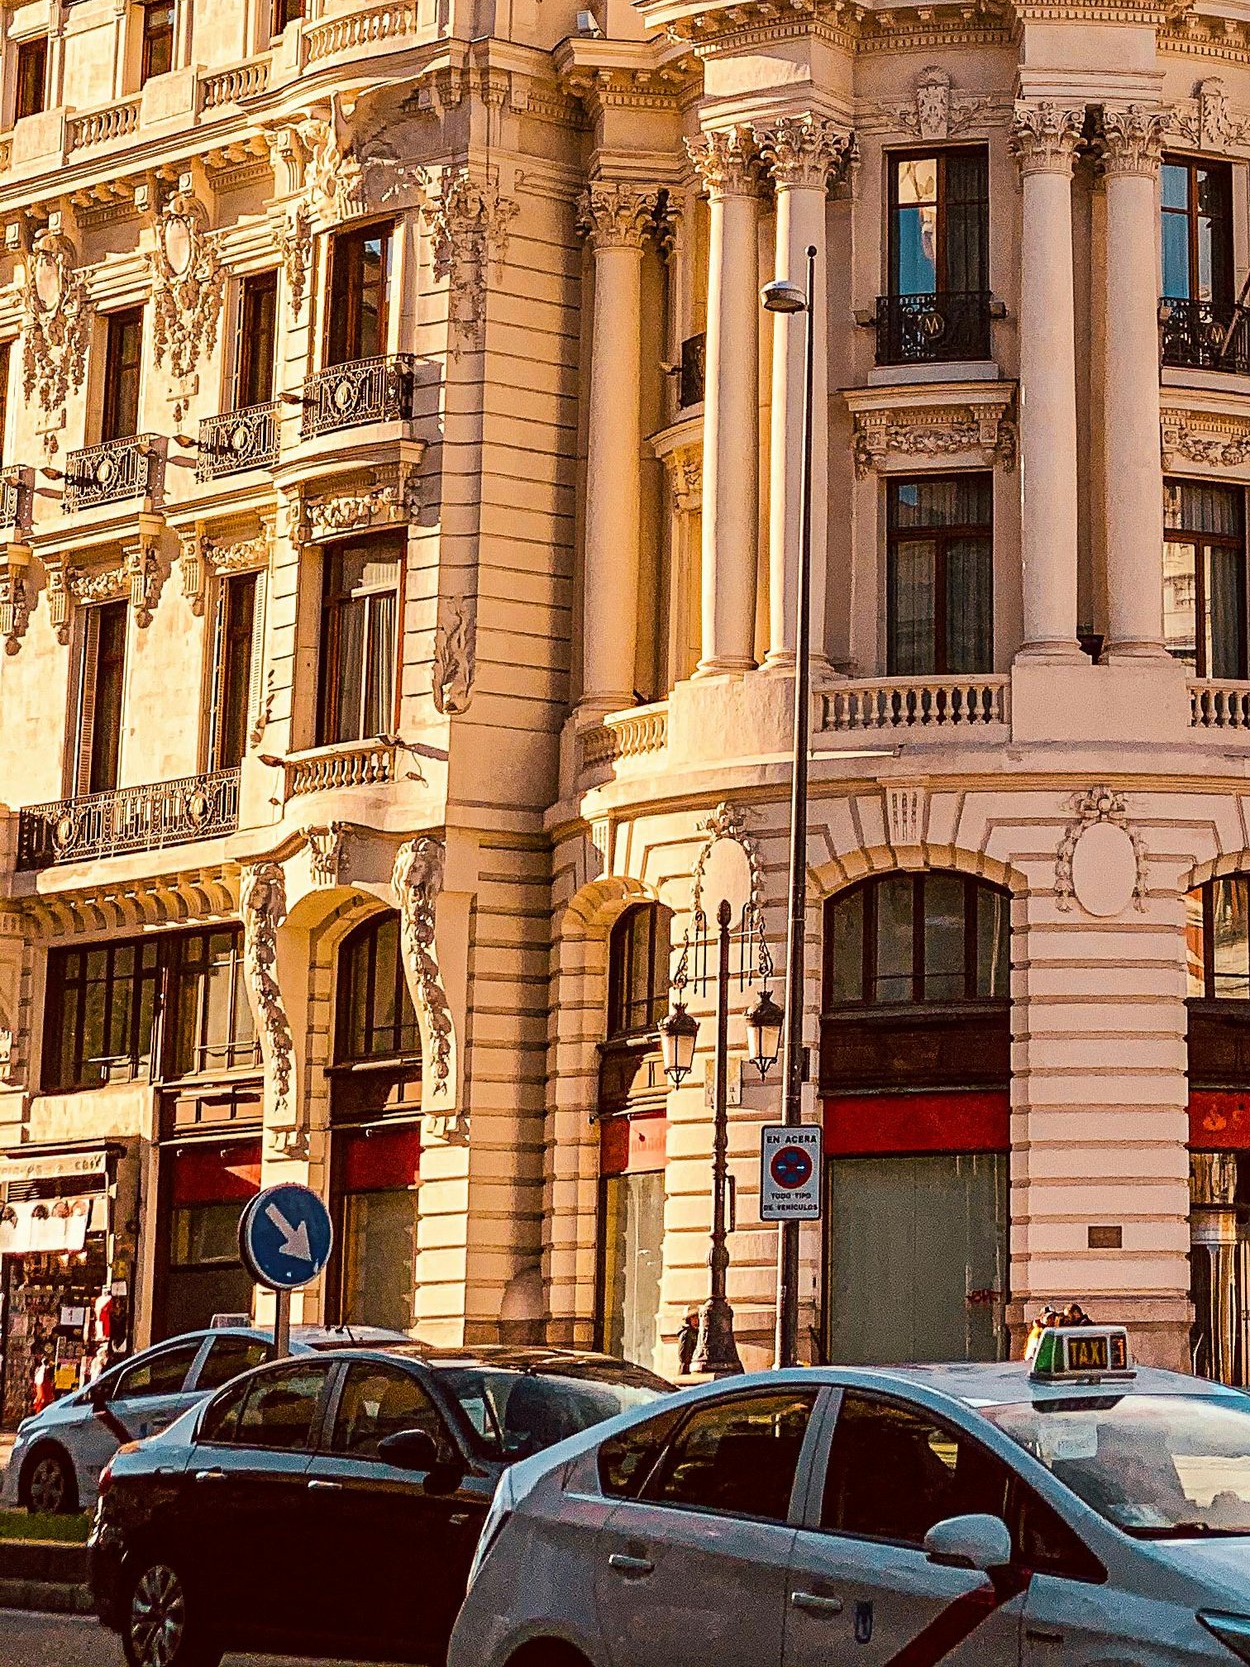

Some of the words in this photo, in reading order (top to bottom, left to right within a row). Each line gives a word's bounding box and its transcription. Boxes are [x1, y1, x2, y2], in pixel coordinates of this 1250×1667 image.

[766, 1135, 780, 1143] EN
[785, 1135, 817, 1144] ACERA
[771, 1192, 791, 1200] TODO
[1070, 1341, 1106, 1366] TAXI
